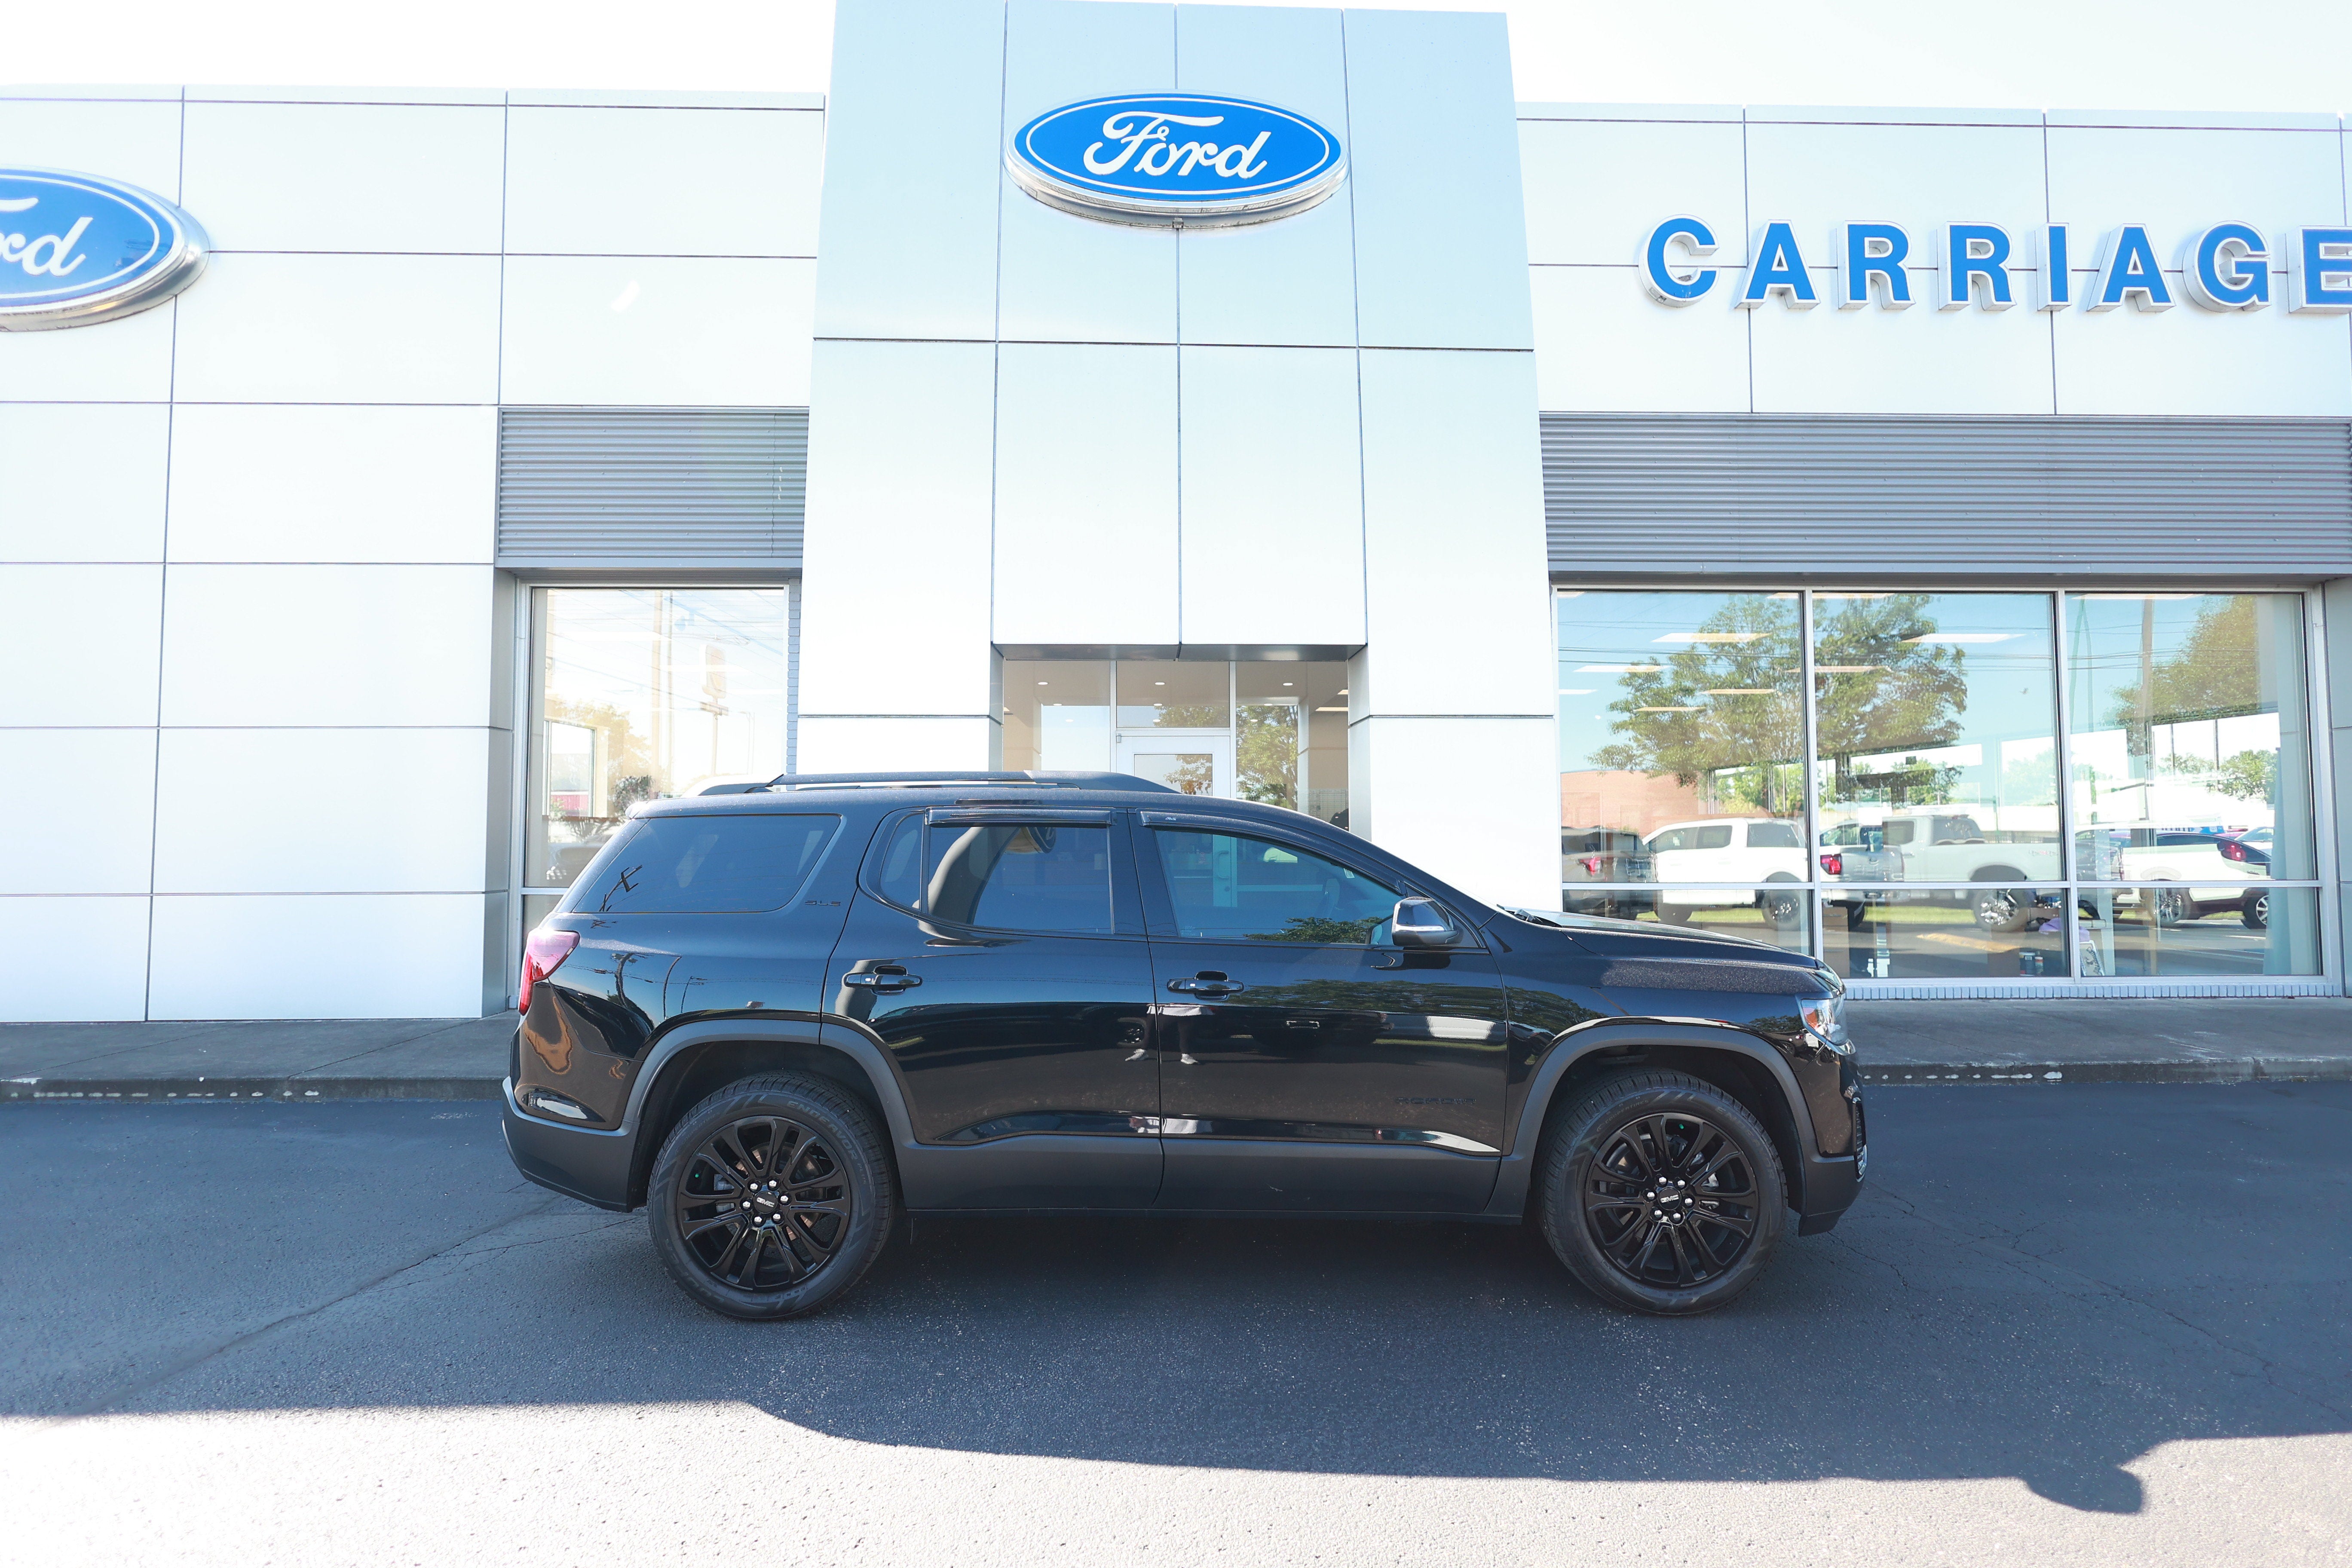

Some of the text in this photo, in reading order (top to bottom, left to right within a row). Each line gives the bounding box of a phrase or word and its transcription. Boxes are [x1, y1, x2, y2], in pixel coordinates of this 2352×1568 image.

[1083, 110, 1272, 178] Ford
[1639, 214, 2352, 314] CARRIAGE
[786, 1100, 858, 1160] ENDEAVOR
[756, 1197, 775, 1207] GMC
[1660, 1194, 1679, 1203] GMC
